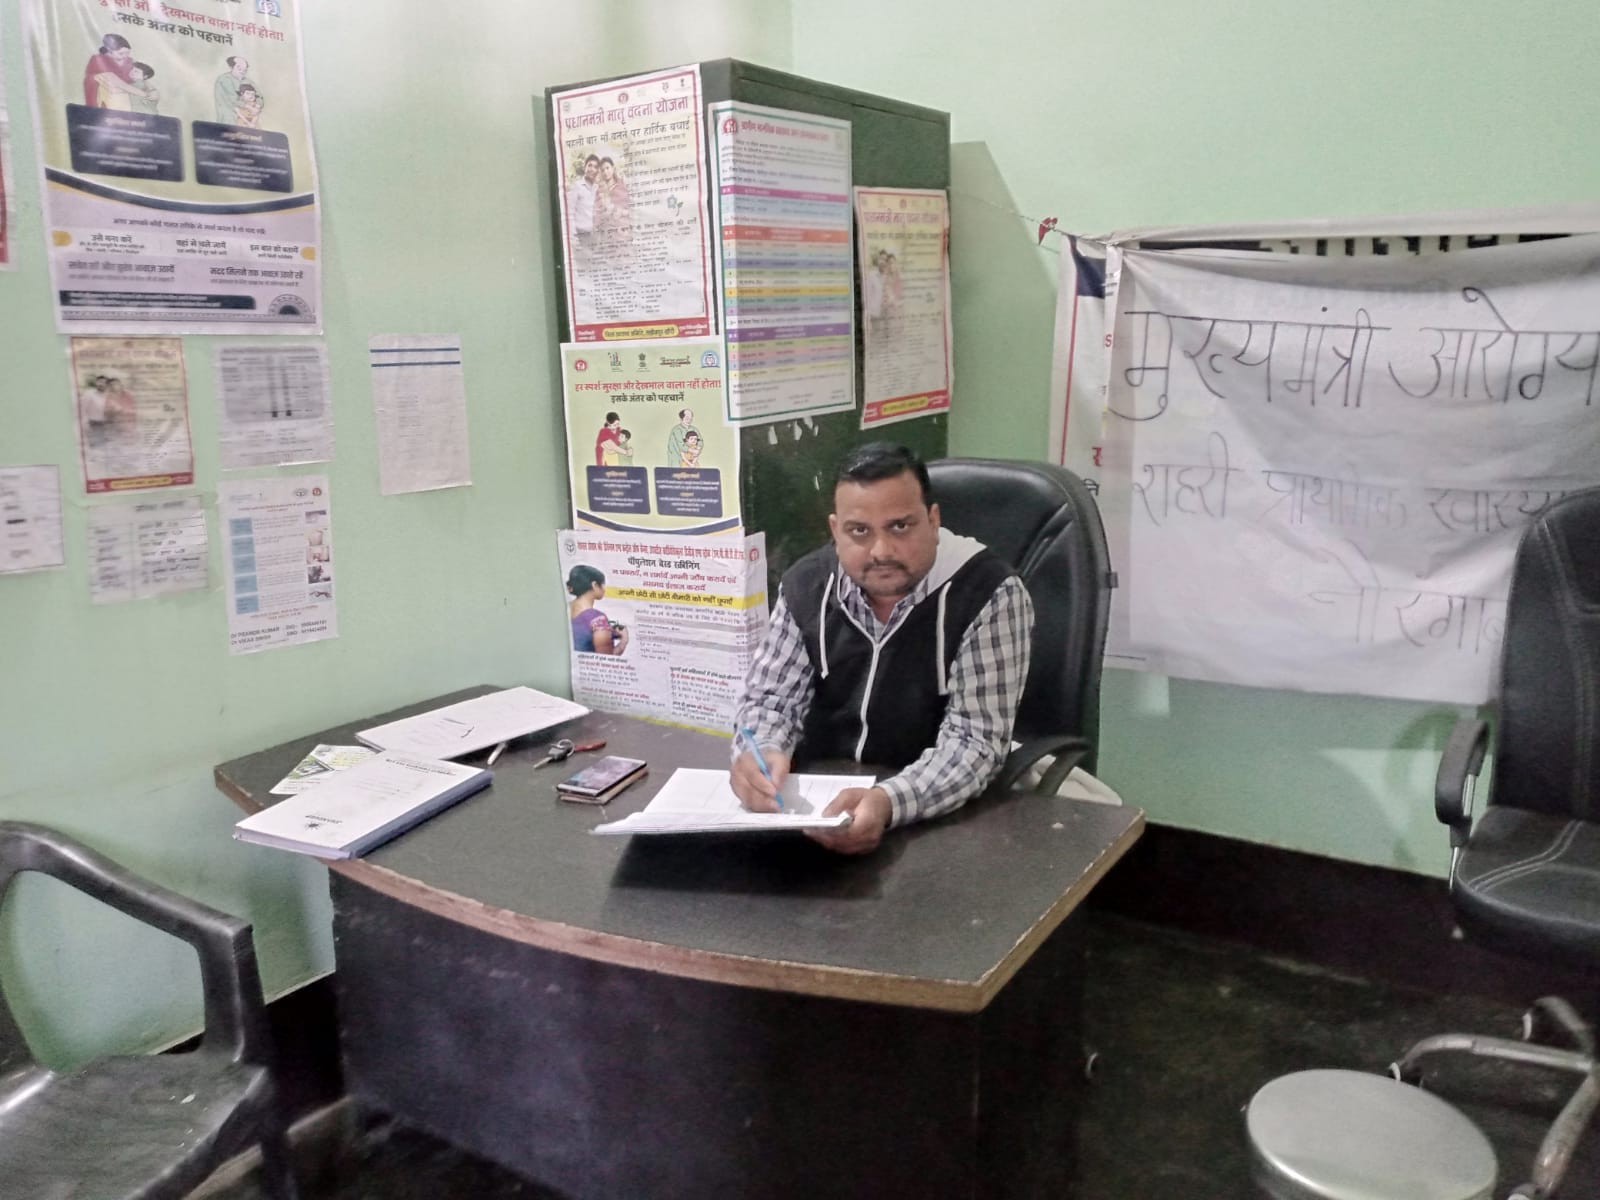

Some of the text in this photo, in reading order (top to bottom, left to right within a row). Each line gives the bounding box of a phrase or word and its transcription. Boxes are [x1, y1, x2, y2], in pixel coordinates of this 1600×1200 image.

[178, 23, 194, 39] को
[196, 30, 233, 46] पहचानें
[655, 95, 689, 113] योजना
[1387, 286, 1600, 407] आरोग्य
[575, 383, 583, 391] हर
[584, 380, 601, 391] स्पर्श
[601, 382, 621, 393] सुरक्षा
[623, 380, 634, 390] और
[634, 380, 665, 390] देखभाल
[666, 381, 685, 389] वाला
[685, 378, 700, 389] नहीं
[610, 391, 685, 404] इसके अंतर को पहचानें
[1133, 431, 1242, 527] शहरी
